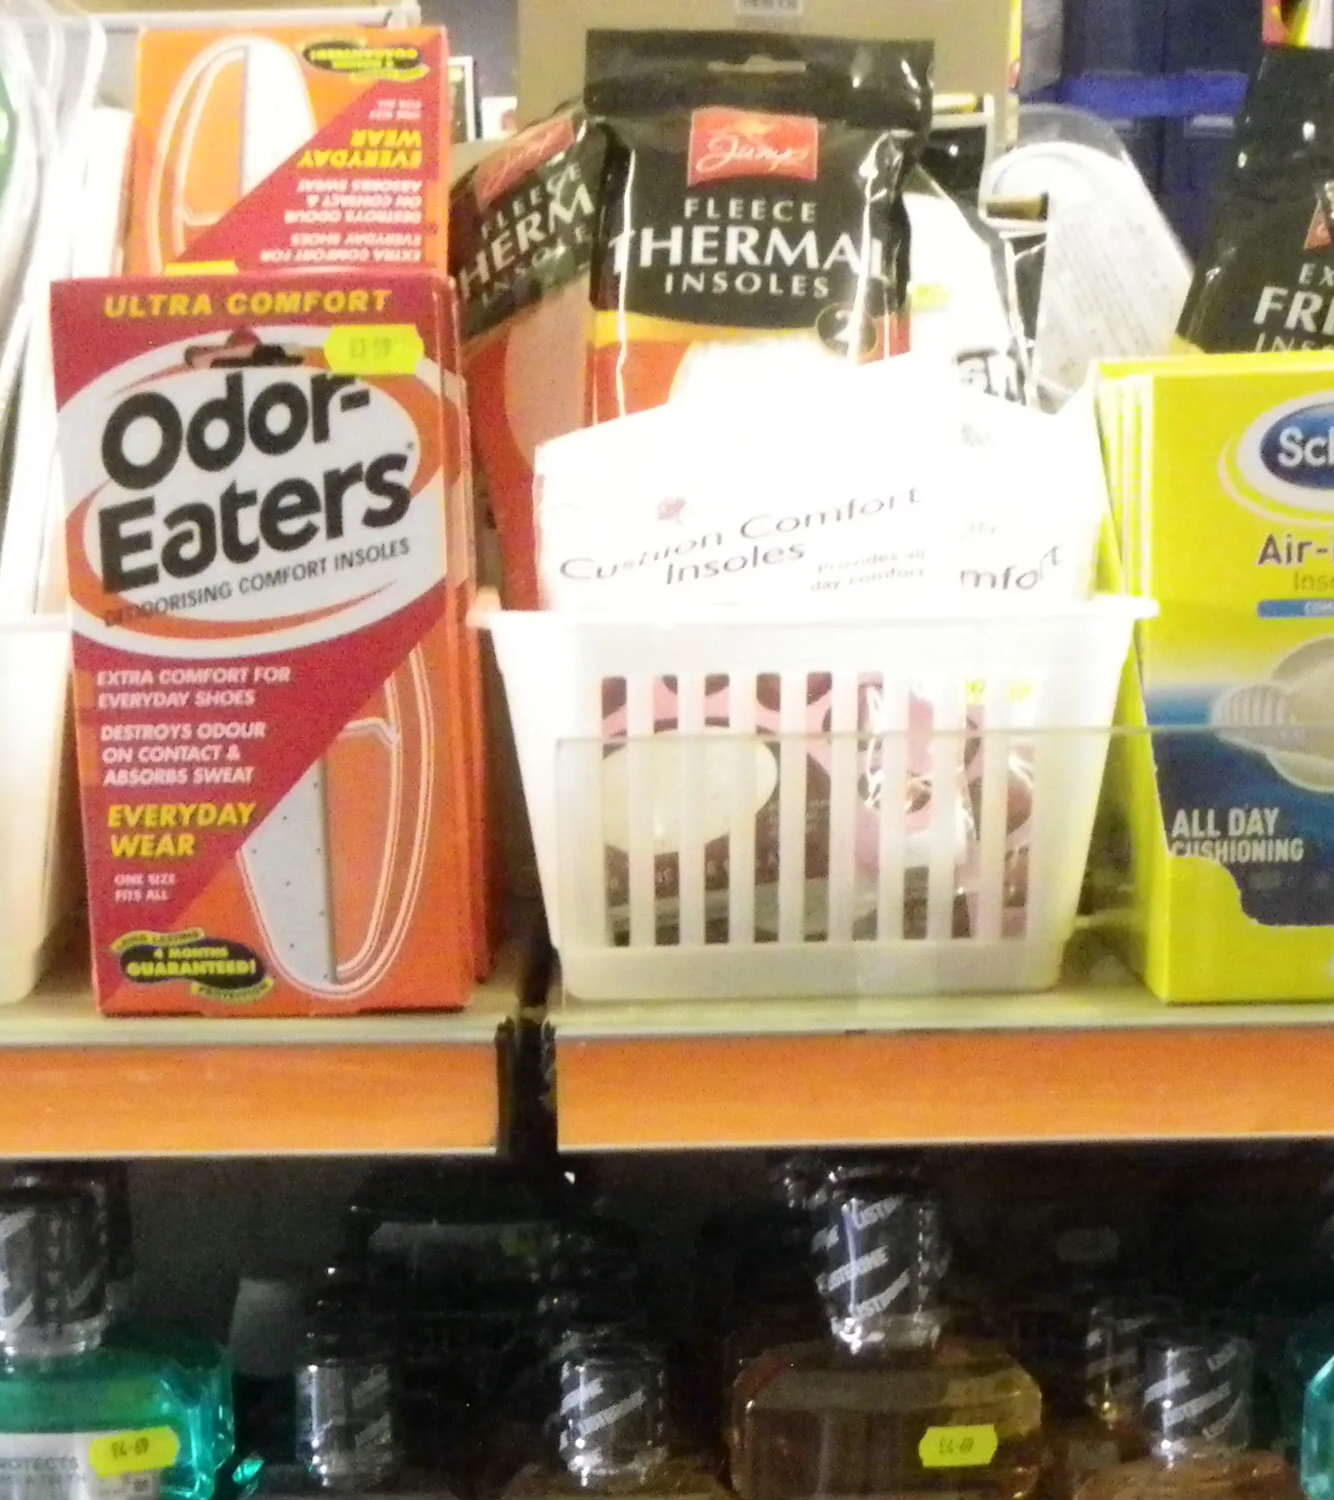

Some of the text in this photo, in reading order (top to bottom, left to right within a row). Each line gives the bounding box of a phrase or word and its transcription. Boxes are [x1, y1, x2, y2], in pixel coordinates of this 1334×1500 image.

[683, 197, 817, 222] FLEECE
[665, 272, 830, 299] INSOLES
[105, 289, 391, 318] ULTRA COMFORT
[101, 369, 371, 490] Odor-
[98, 452, 412, 595] Eaters
[739, 487, 922, 541] Comfort
[238, 557, 328, 595] COMFORT
[334, 537, 411, 572] INSOLES
[666, 542, 806, 586] Insoles
[97, 665, 292, 688] EXTRA COMFORT FOR
[98, 689, 257, 711] EVERYDAY SHOES
[101, 721, 267, 742] DESTROYS ODOUR
[102, 746, 134, 764] ON
[137, 744, 221, 763] CONTACT
[103, 766, 256, 787] ABSORBS SWEAT
[107, 803, 257, 830] EVERYDAY
[1171, 806, 1281, 841] ALL DAY
[110, 833, 196, 859] WEAR
